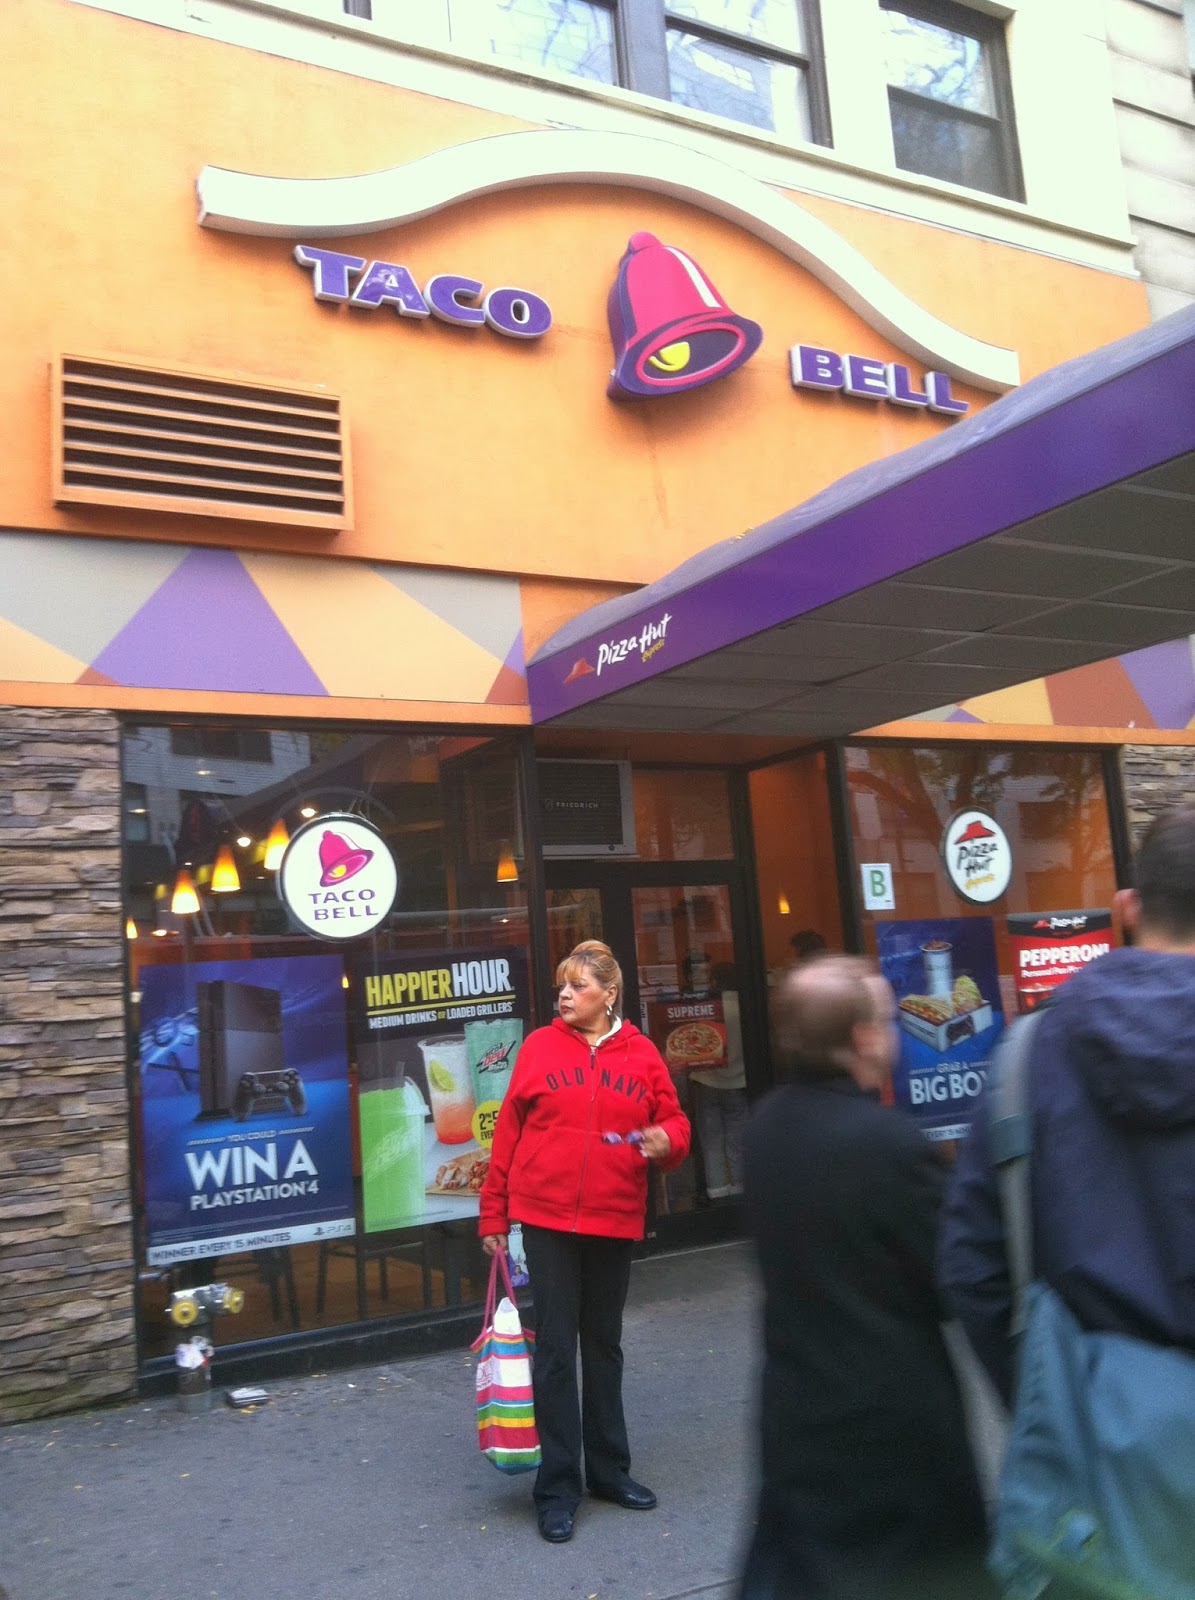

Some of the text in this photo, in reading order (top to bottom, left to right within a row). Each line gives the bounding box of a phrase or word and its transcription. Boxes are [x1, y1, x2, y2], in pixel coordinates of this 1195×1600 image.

[294, 244, 969, 415] TACO BELL
[597, 613, 672, 676] Pizza Hut
[556, 801, 599, 809] FRIEDRICH
[957, 843, 999, 870] Pizza
[308, 889, 376, 905] TACO
[870, 870, 886, 897] B
[314, 905, 379, 920] BELL
[1019, 943, 1110, 967] PEPPERONI
[365, 958, 512, 1007] HAPPIER HOUR
[369, 1014, 404, 1029] MEDIUM
[405, 1010, 437, 1024] DRINKS
[447, 1005, 476, 1019] LOADED
[477, 1002, 512, 1016] GRILLERS
[667, 1004, 715, 1019] SUPREME
[546, 1067, 647, 1104] OLD NAVY
[909, 1075, 949, 1104] BIG
[184, 1139, 319, 1190] WIN A
[190, 1182, 306, 1211] PLAYSTATION
[152, 1224, 352, 1260] WINNER EVERY 15 MINUTES PS4
